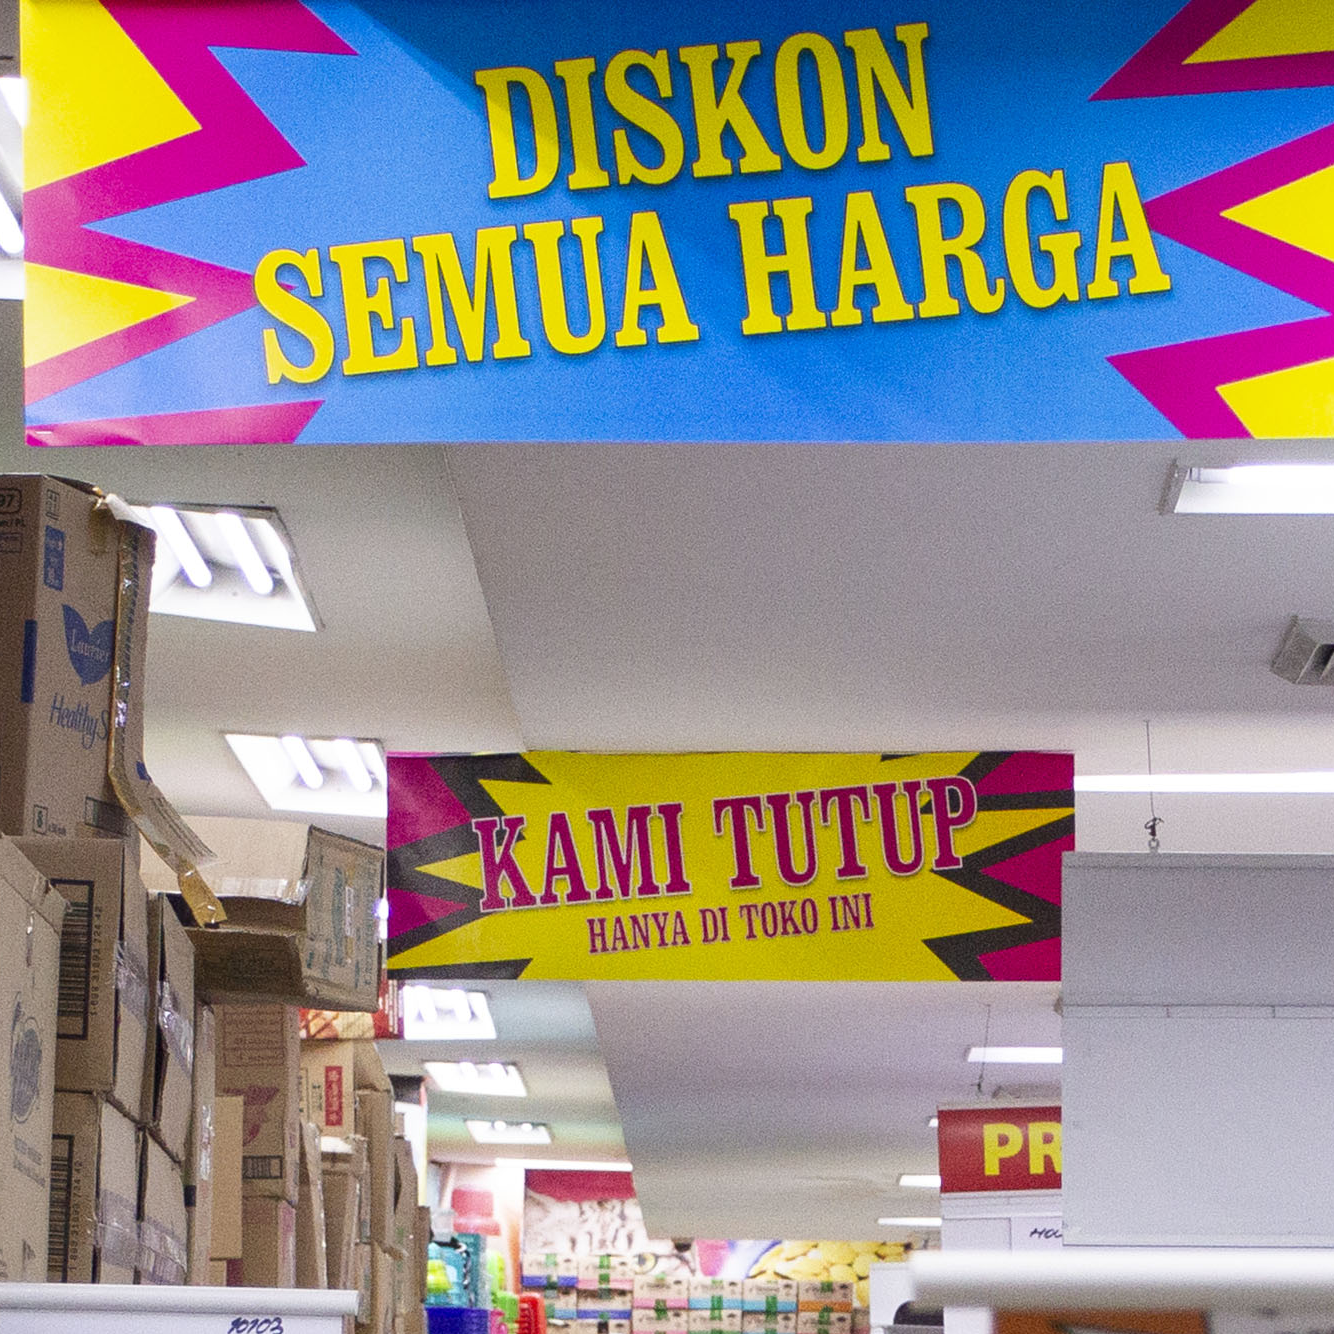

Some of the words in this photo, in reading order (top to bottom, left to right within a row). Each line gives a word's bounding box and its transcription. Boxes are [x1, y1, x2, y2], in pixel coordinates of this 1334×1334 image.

[475, 21, 935, 202] DISKON
[251, 210, 700, 386] SEMUA
[726, 160, 1173, 338] HARGA
[471, 801, 692, 913] KAMI
[713, 774, 978, 891] TUTUP
[586, 909, 691, 955] HANYA
[700, 906, 732, 944] DI
[739, 898, 822, 940] TOKO
[829, 892, 876, 932] INI
